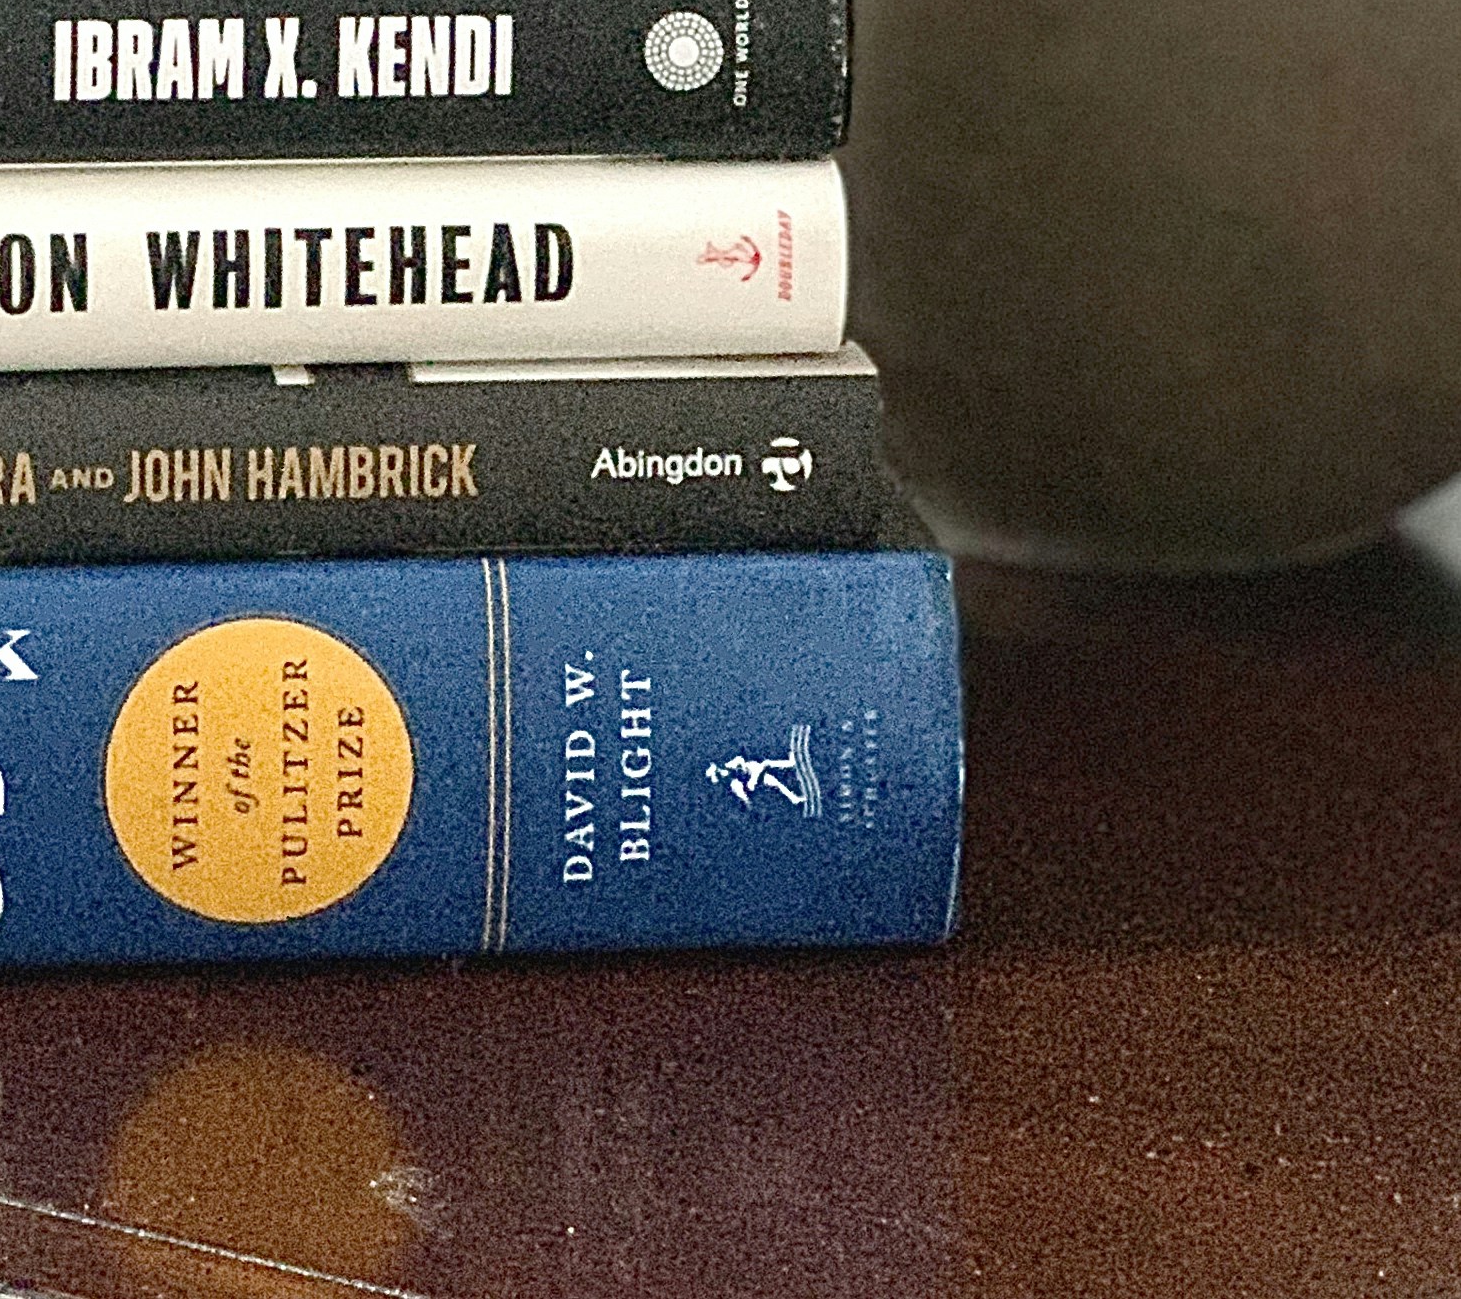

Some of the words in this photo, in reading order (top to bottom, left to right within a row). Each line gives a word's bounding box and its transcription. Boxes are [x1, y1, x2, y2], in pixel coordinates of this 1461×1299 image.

[54, 18, 245, 101] IBRAM
[264, 17, 318, 99] X.
[337, 14, 514, 98] KENDI
[732, 70, 750, 107] ONE
[146, 223, 574, 311] WHITEHEAD
[50, 467, 115, 489] AND
[123, 447, 231, 503] JOHN
[247, 443, 478, 501] HAMBRICK
[590, 446, 743, 485] Abingdon
[564, 650, 595, 707] W.
[171, 681, 200, 872] WINNER
[225, 783, 260, 814] of
[226, 737, 251, 779] the
[279, 660, 309, 888] PULITZER
[336, 706, 365, 838] PRIZE
[619, 669, 652, 861] BLIGHT
[563, 729, 596, 882] DAVID
